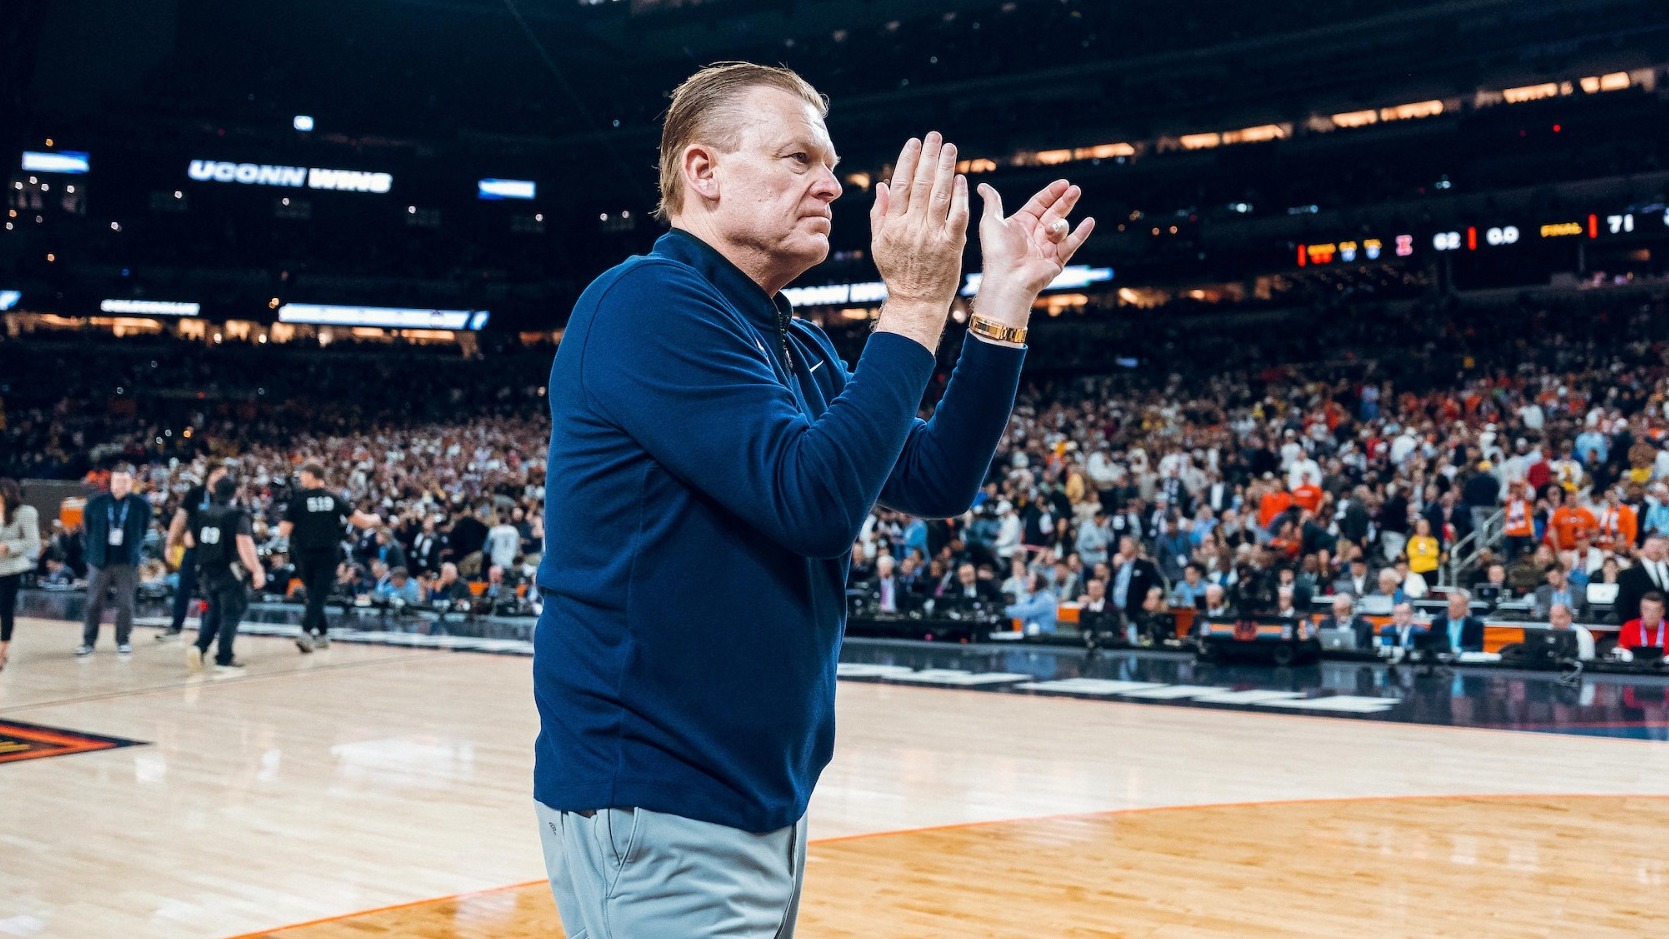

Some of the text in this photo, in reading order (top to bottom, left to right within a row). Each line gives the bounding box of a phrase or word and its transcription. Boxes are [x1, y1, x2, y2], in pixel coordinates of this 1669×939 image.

[188, 159, 394, 194] UCONN WINS
[1432, 231, 1461, 251] 62
[1606, 213, 1634, 234] 71
